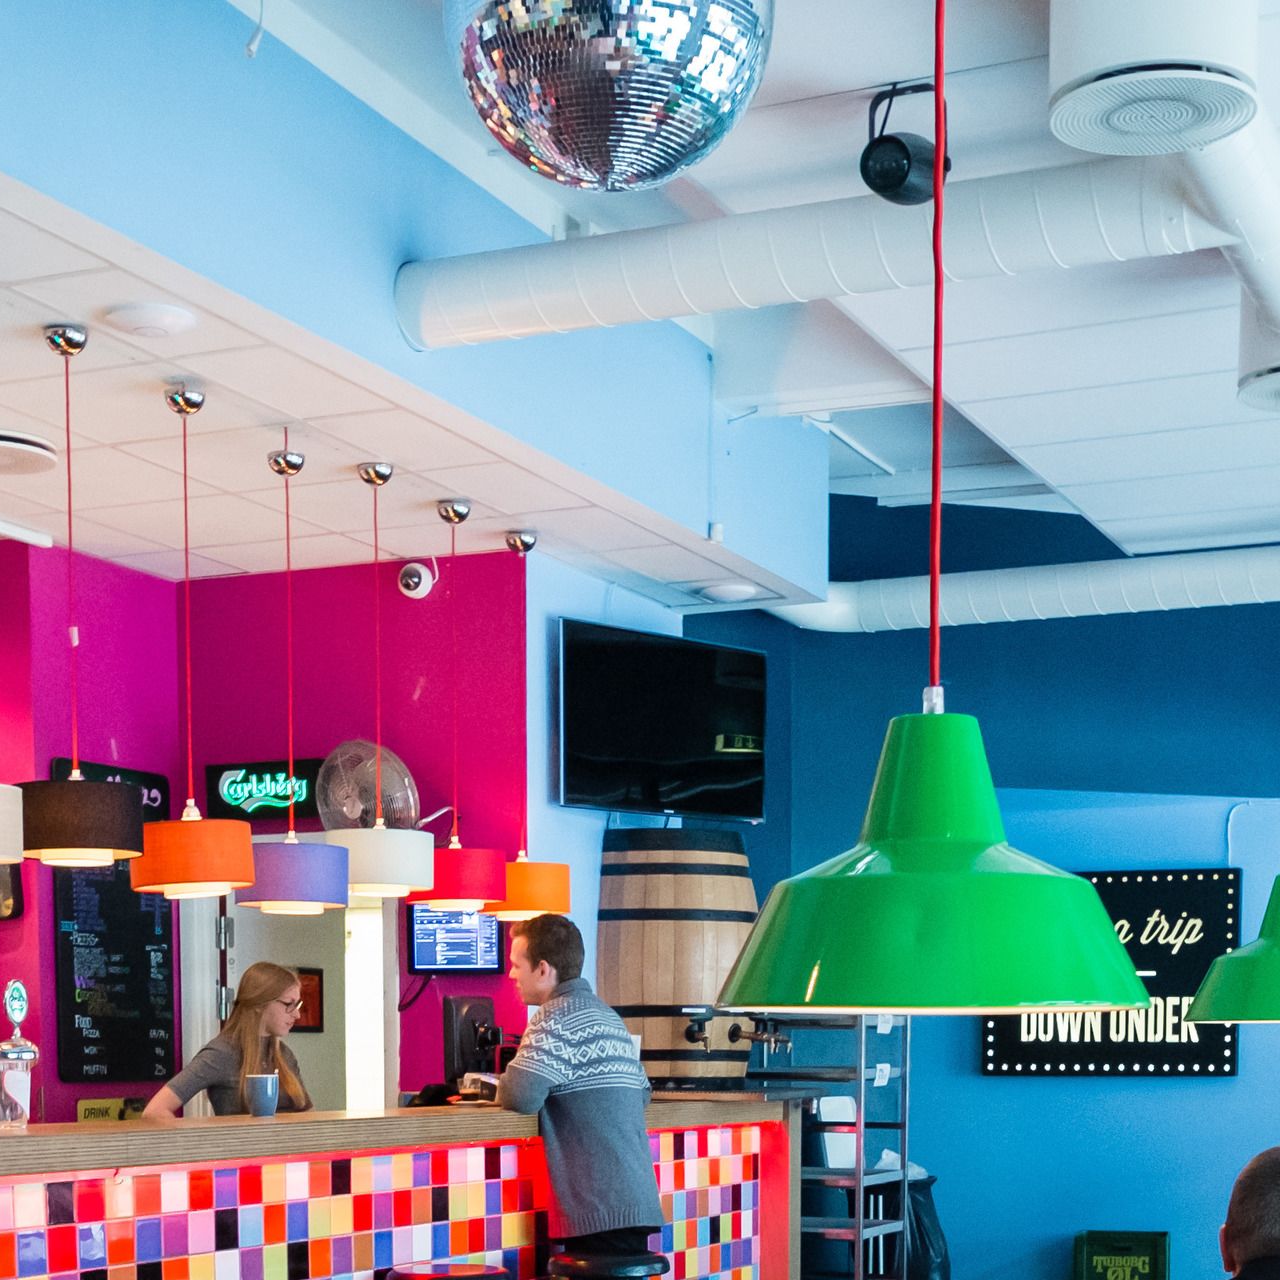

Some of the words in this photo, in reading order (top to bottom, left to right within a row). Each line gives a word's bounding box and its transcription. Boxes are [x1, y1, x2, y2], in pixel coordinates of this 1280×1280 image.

[218, 768, 308, 807] Carlsberg
[1140, 908, 1204, 955] trip
[83, 1107, 111, 1120] DRINK
[1092, 1255, 1150, 1274] TUBORG
